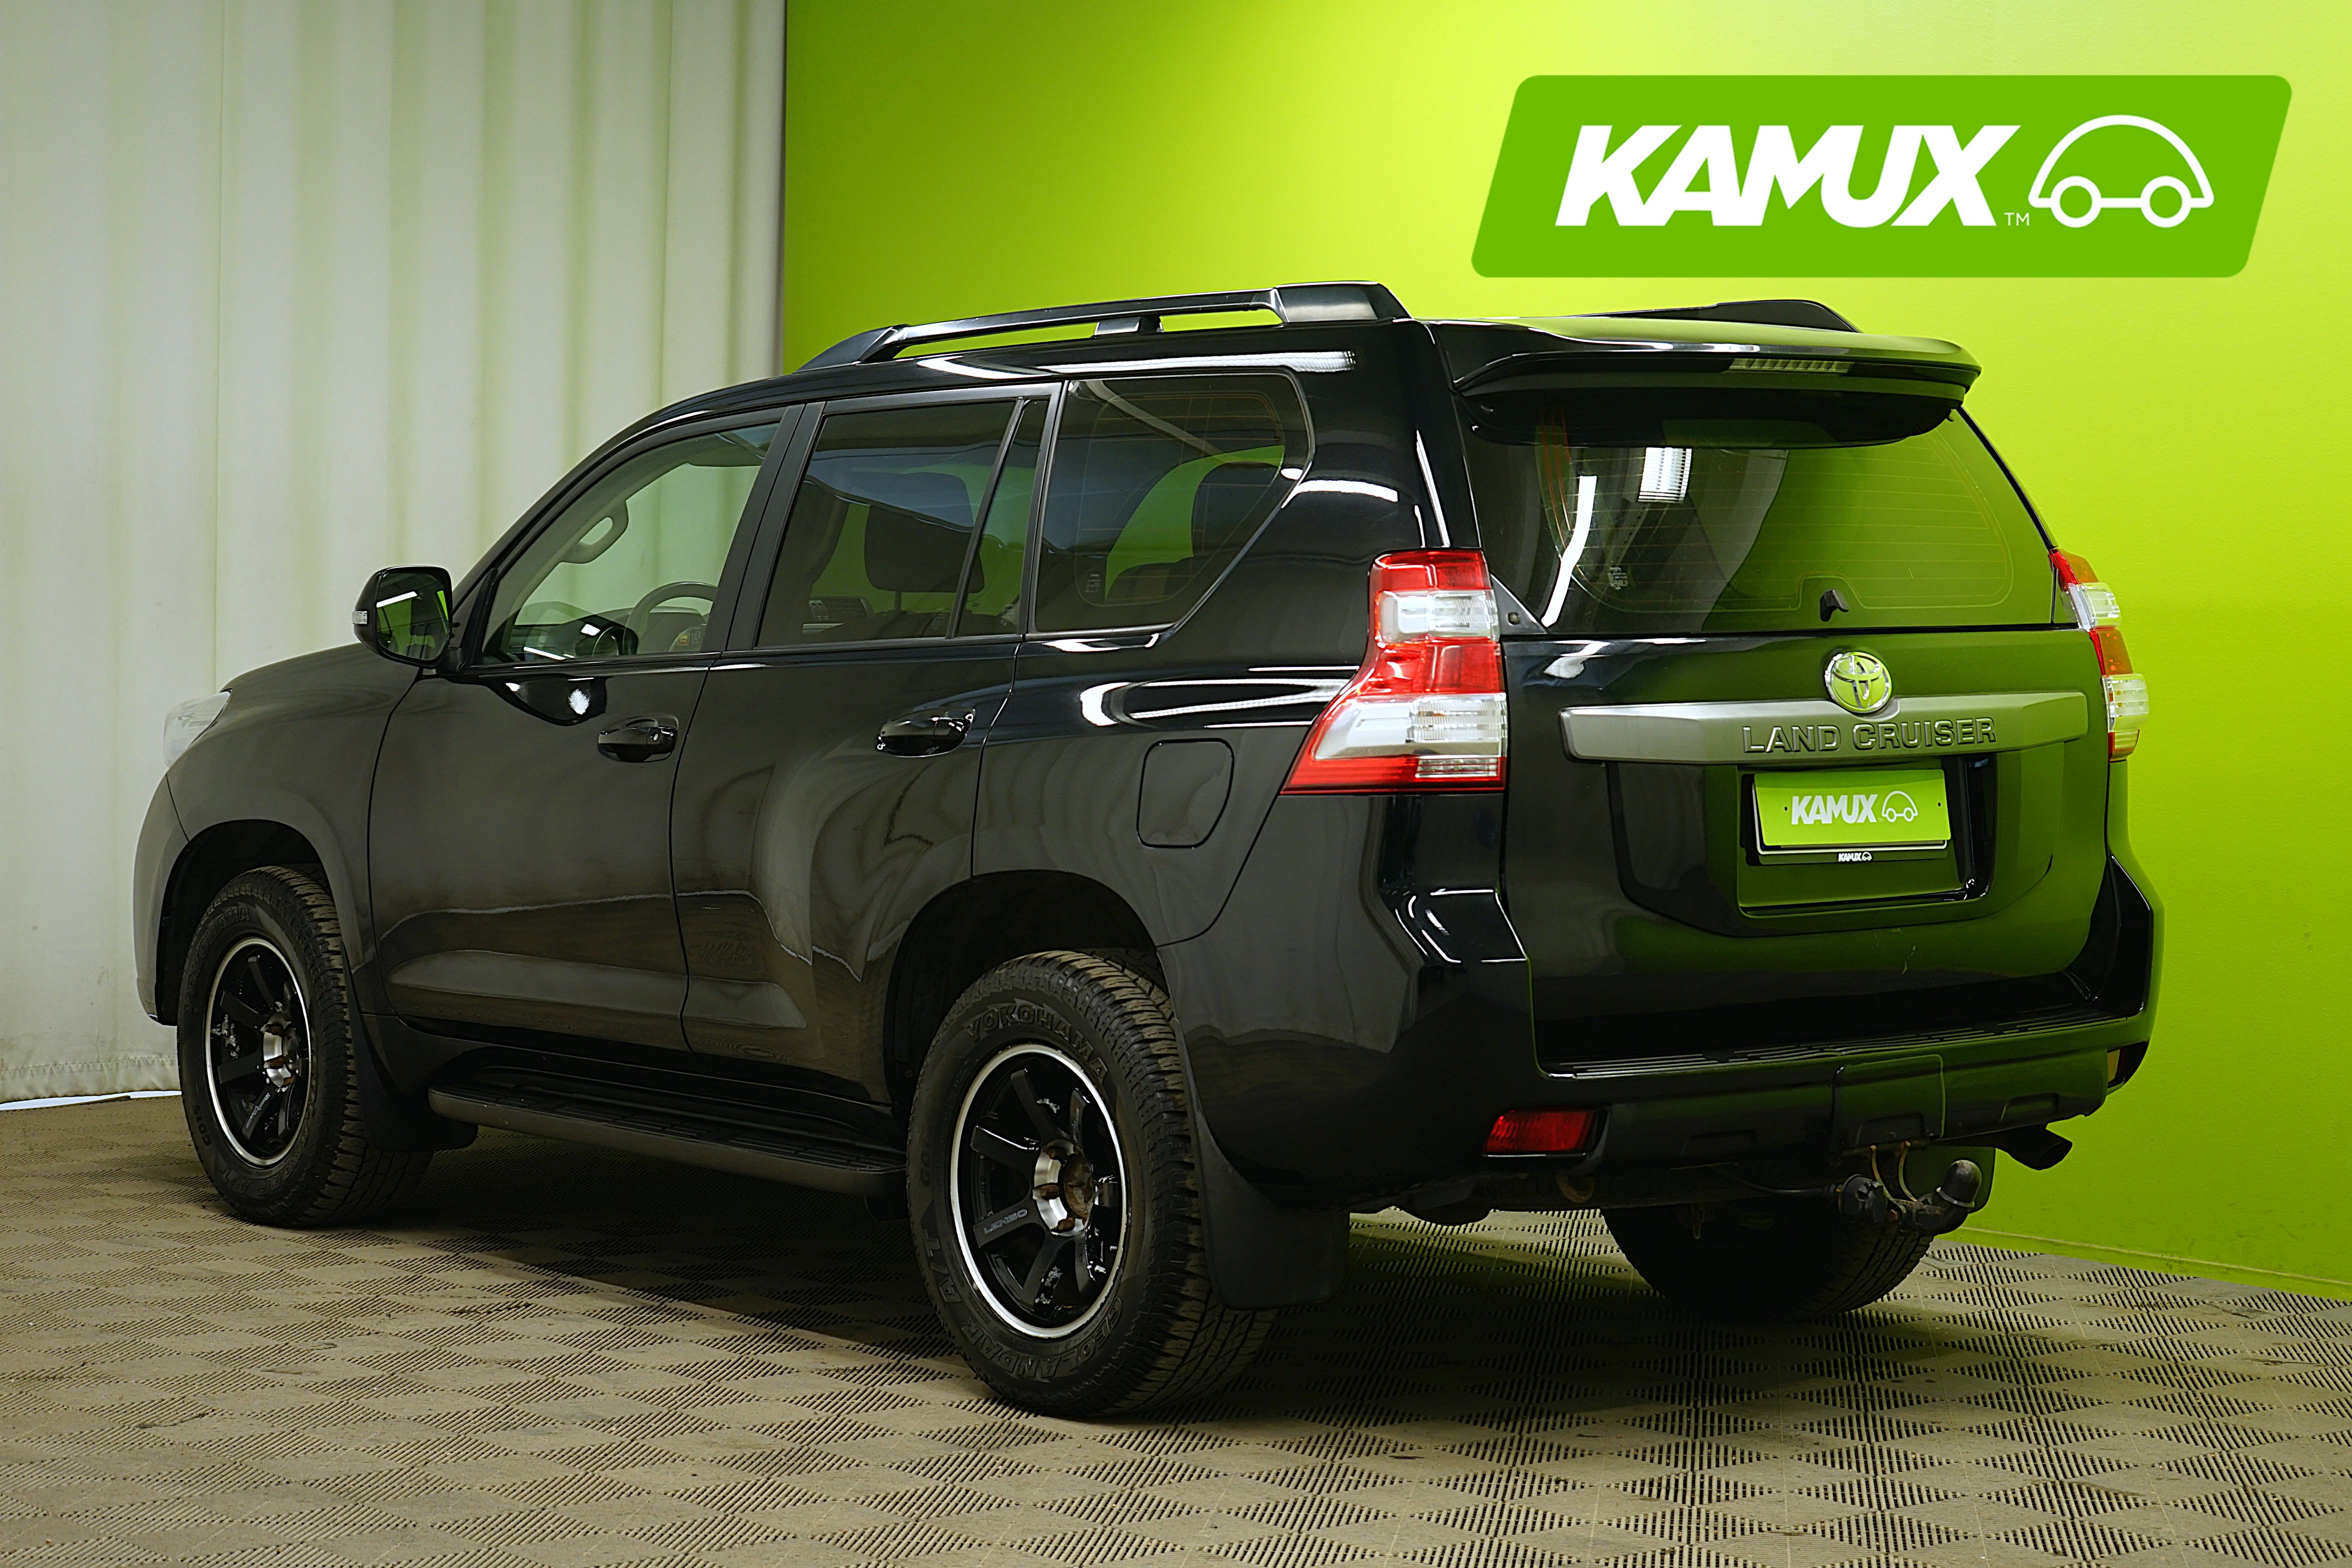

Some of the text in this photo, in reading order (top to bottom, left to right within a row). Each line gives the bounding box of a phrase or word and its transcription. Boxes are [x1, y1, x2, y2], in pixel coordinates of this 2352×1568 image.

[1742, 717, 1996, 753] LAND CRUISER
[1791, 794, 1878, 825] KAMUX
[1838, 852, 1862, 862] KAMUX
[965, 1004, 1109, 1085] YOKOHAMA
[984, 1209, 1028, 1235] LENSO
[960, 1297, 1122, 1378] GEOLANDAR
